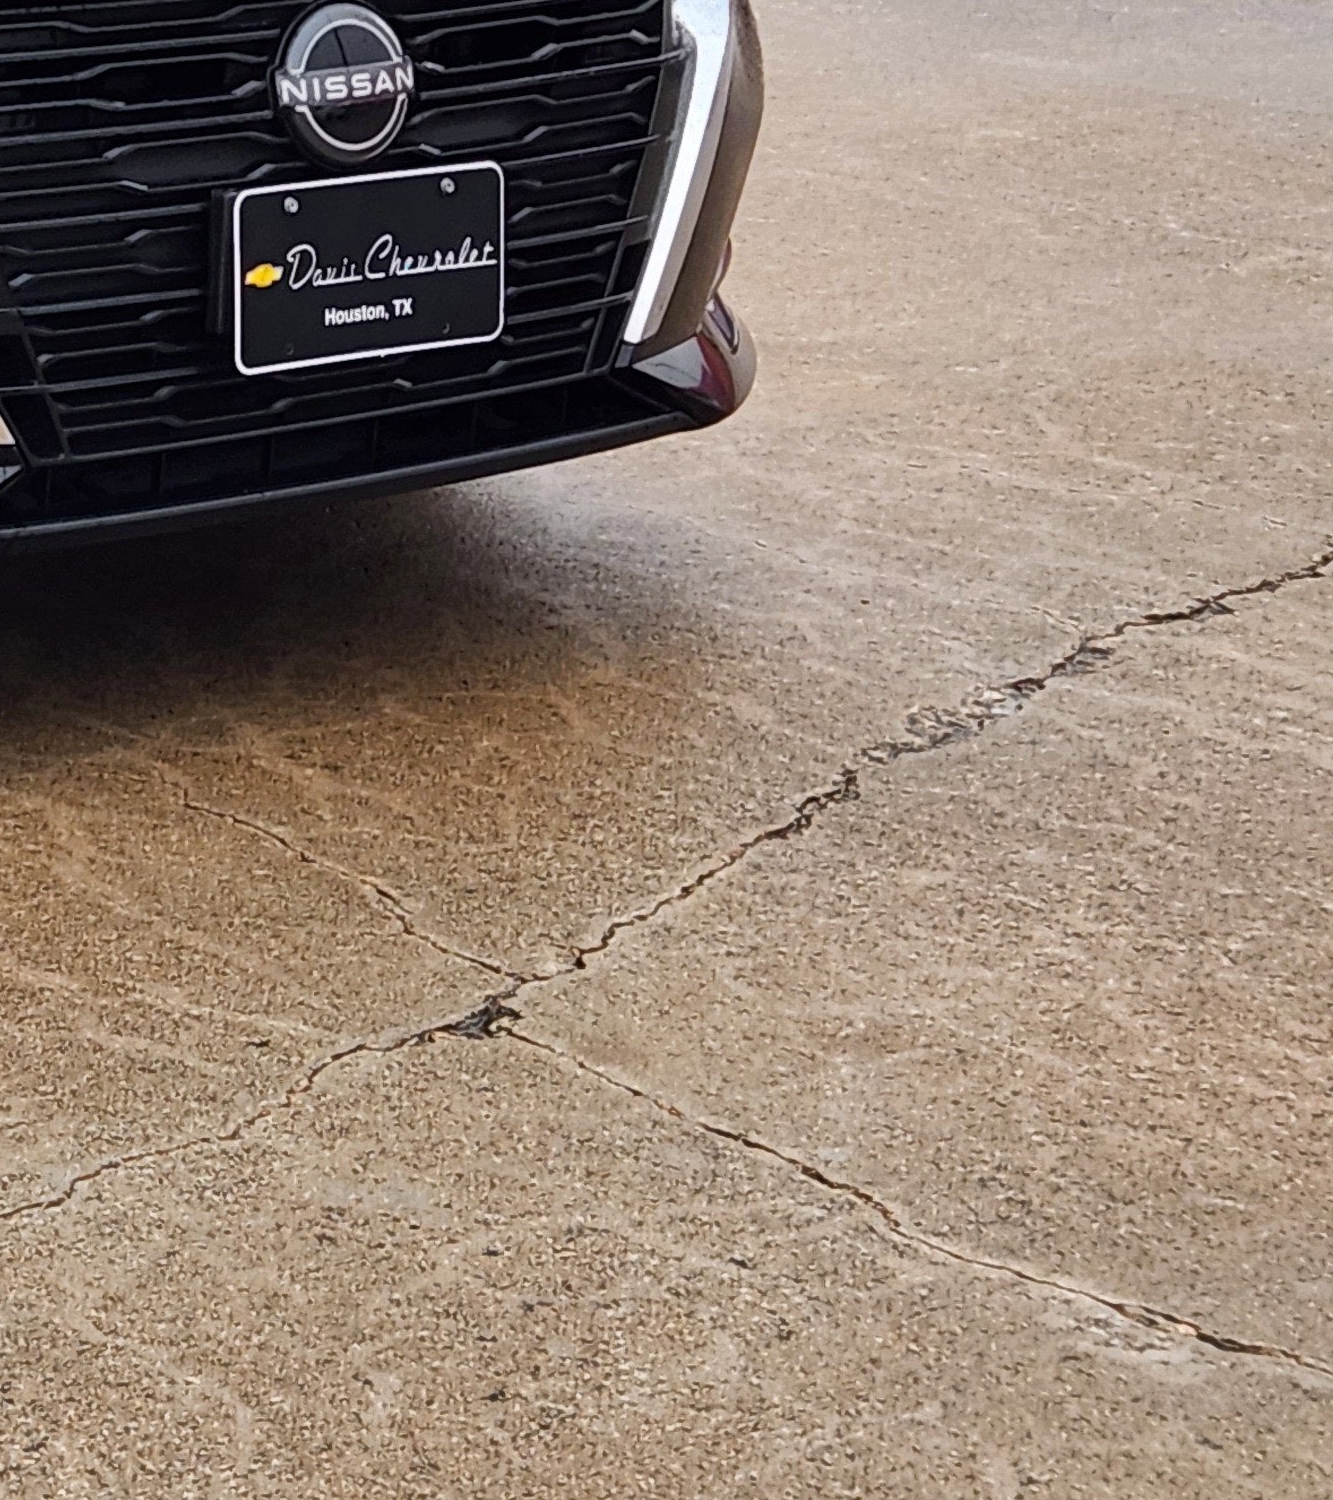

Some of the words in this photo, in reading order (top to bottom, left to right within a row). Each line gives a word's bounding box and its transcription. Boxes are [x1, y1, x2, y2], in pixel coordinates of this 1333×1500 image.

[280, 65, 414, 104] NISSAN
[286, 244, 363, 290] Davis
[365, 233, 498, 280] Chevrolet
[323, 301, 390, 327] Houston,
[392, 298, 414, 317] TX
